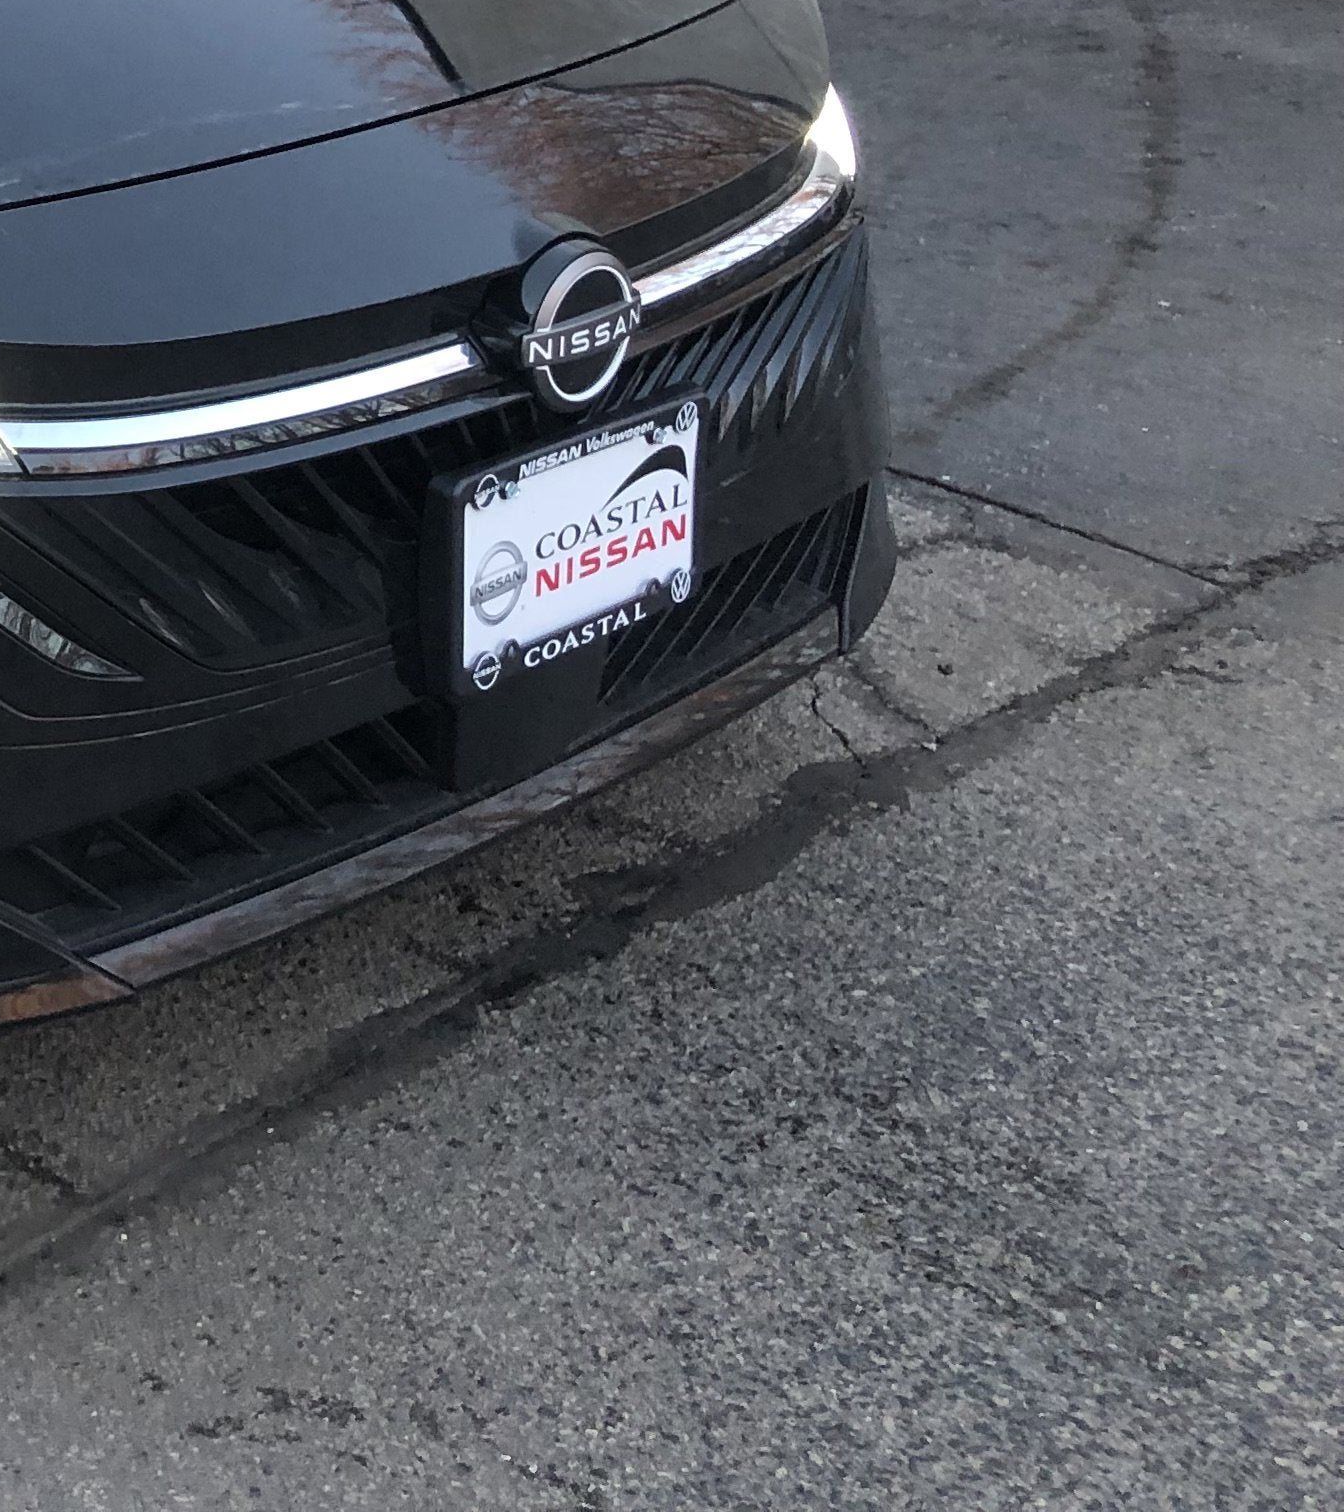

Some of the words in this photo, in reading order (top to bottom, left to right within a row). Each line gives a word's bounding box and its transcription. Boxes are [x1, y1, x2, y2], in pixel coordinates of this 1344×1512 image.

[529, 303, 641, 363] NISSAN
[519, 443, 582, 480] NISSAN
[585, 420, 655, 455] Volkswagen
[535, 483, 688, 560] COASTAL
[474, 568, 523, 598] NISSAN
[535, 514, 687, 597] NISSAN
[524, 602, 647, 668] COASTAL
